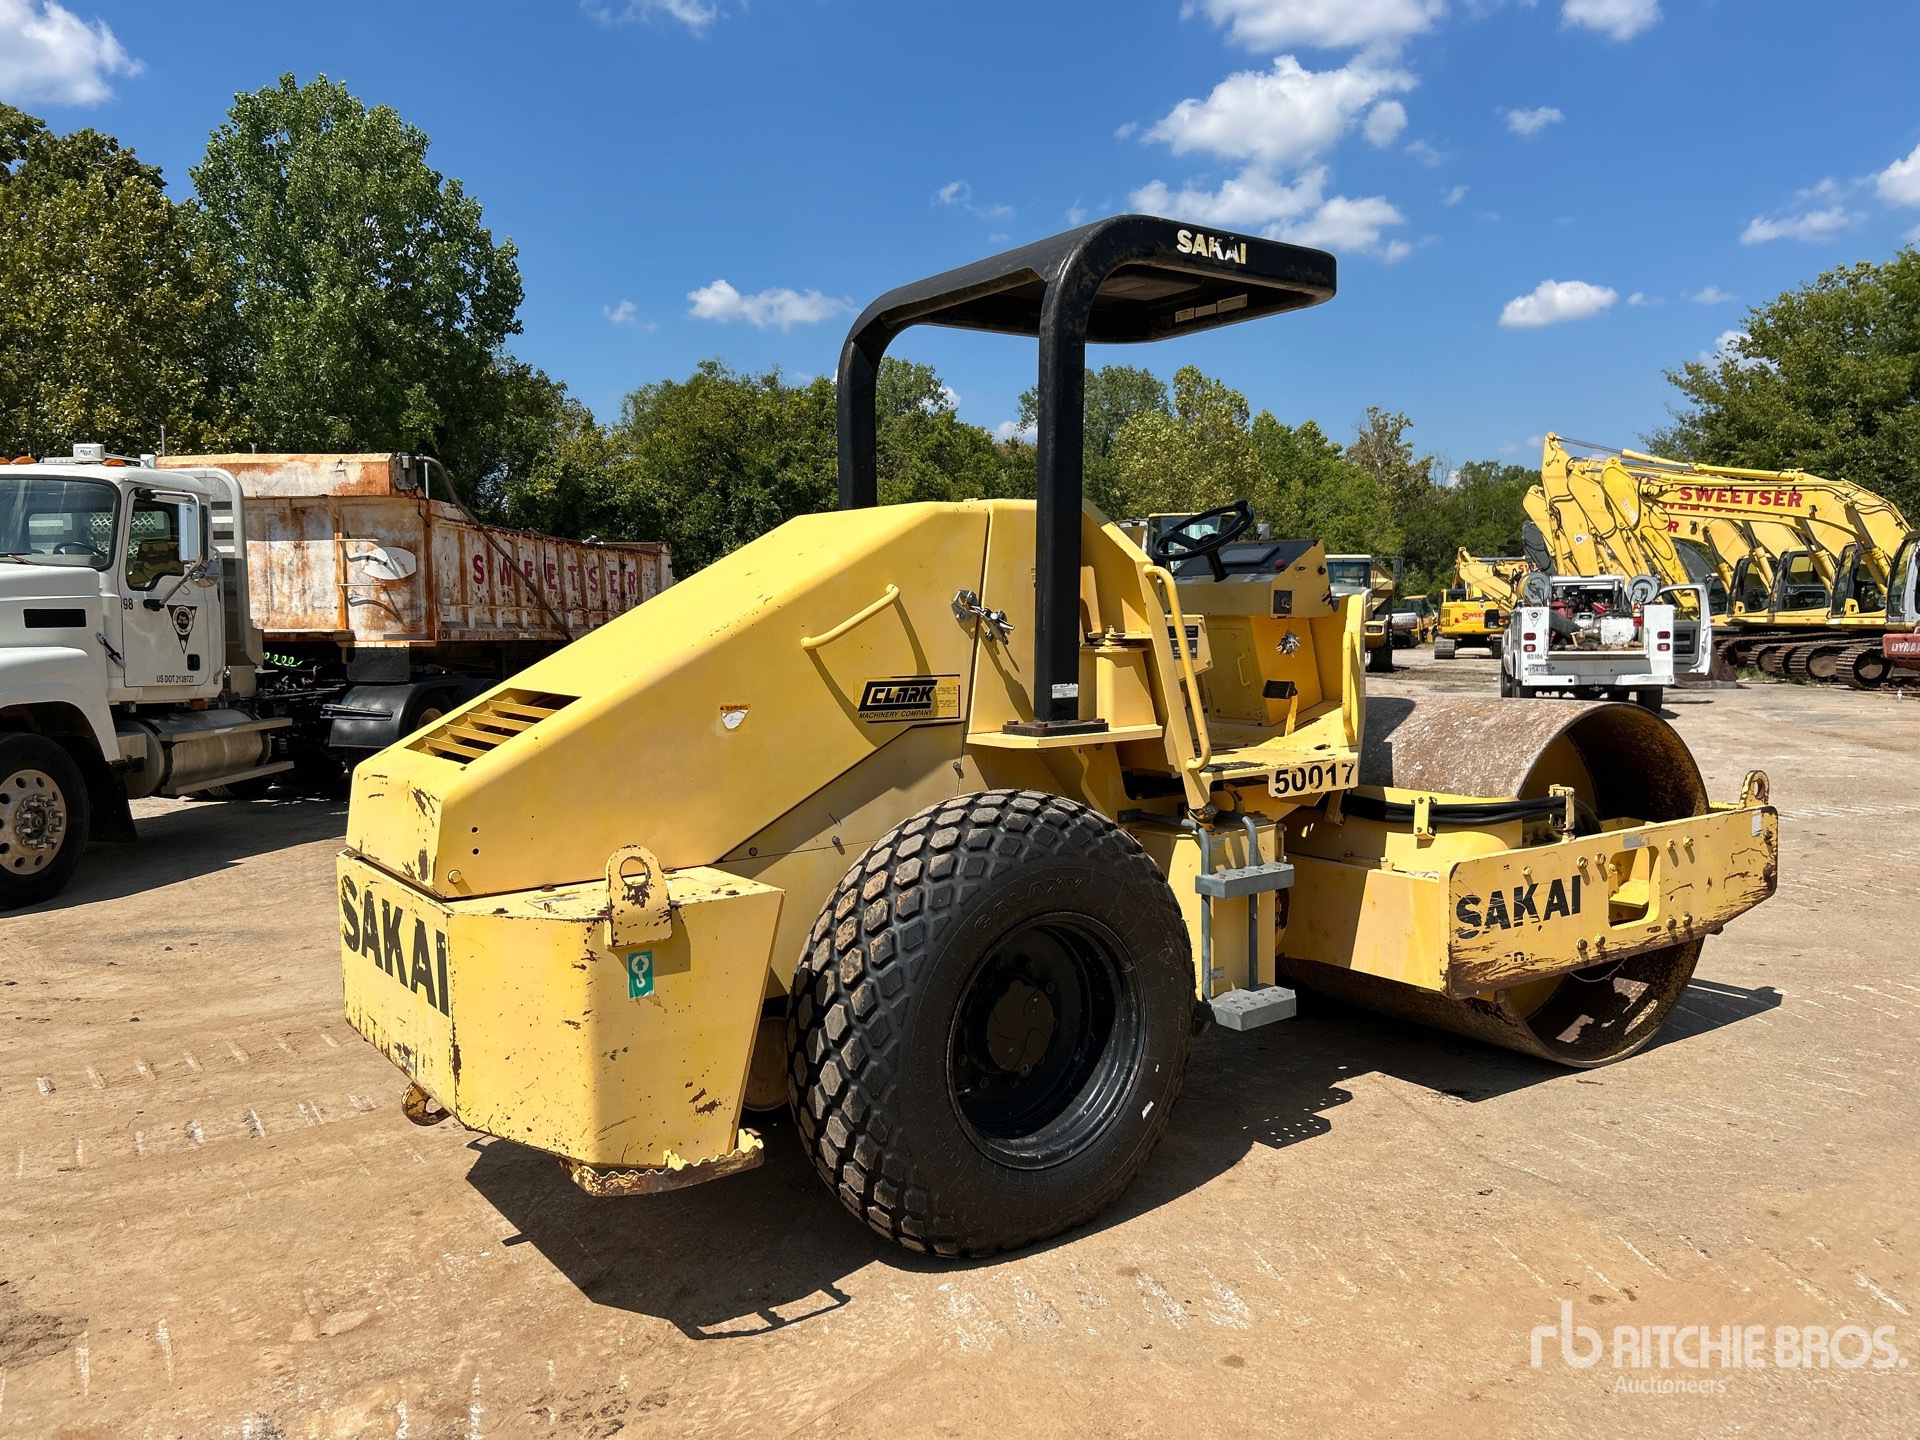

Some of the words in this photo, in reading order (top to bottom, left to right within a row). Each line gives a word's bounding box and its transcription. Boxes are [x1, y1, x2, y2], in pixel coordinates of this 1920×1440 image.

[1176, 229, 1247, 265] SAKAI
[1679, 486, 1803, 508] SWEETSER
[472, 554, 637, 595] SWEETSER
[123, 598, 134, 610] 98
[156, 674, 164, 683] US
[165, 674, 175, 683] DOT
[870, 686, 936, 704] CLARK
[859, 710, 899, 719] MACHINERY
[900, 709, 933, 717] COMPANY
[1274, 763, 1356, 795] 50017
[973, 876, 1085, 931] GALAXY
[1456, 874, 1582, 941] SAKAI
[340, 874, 450, 1018] SAKAI
